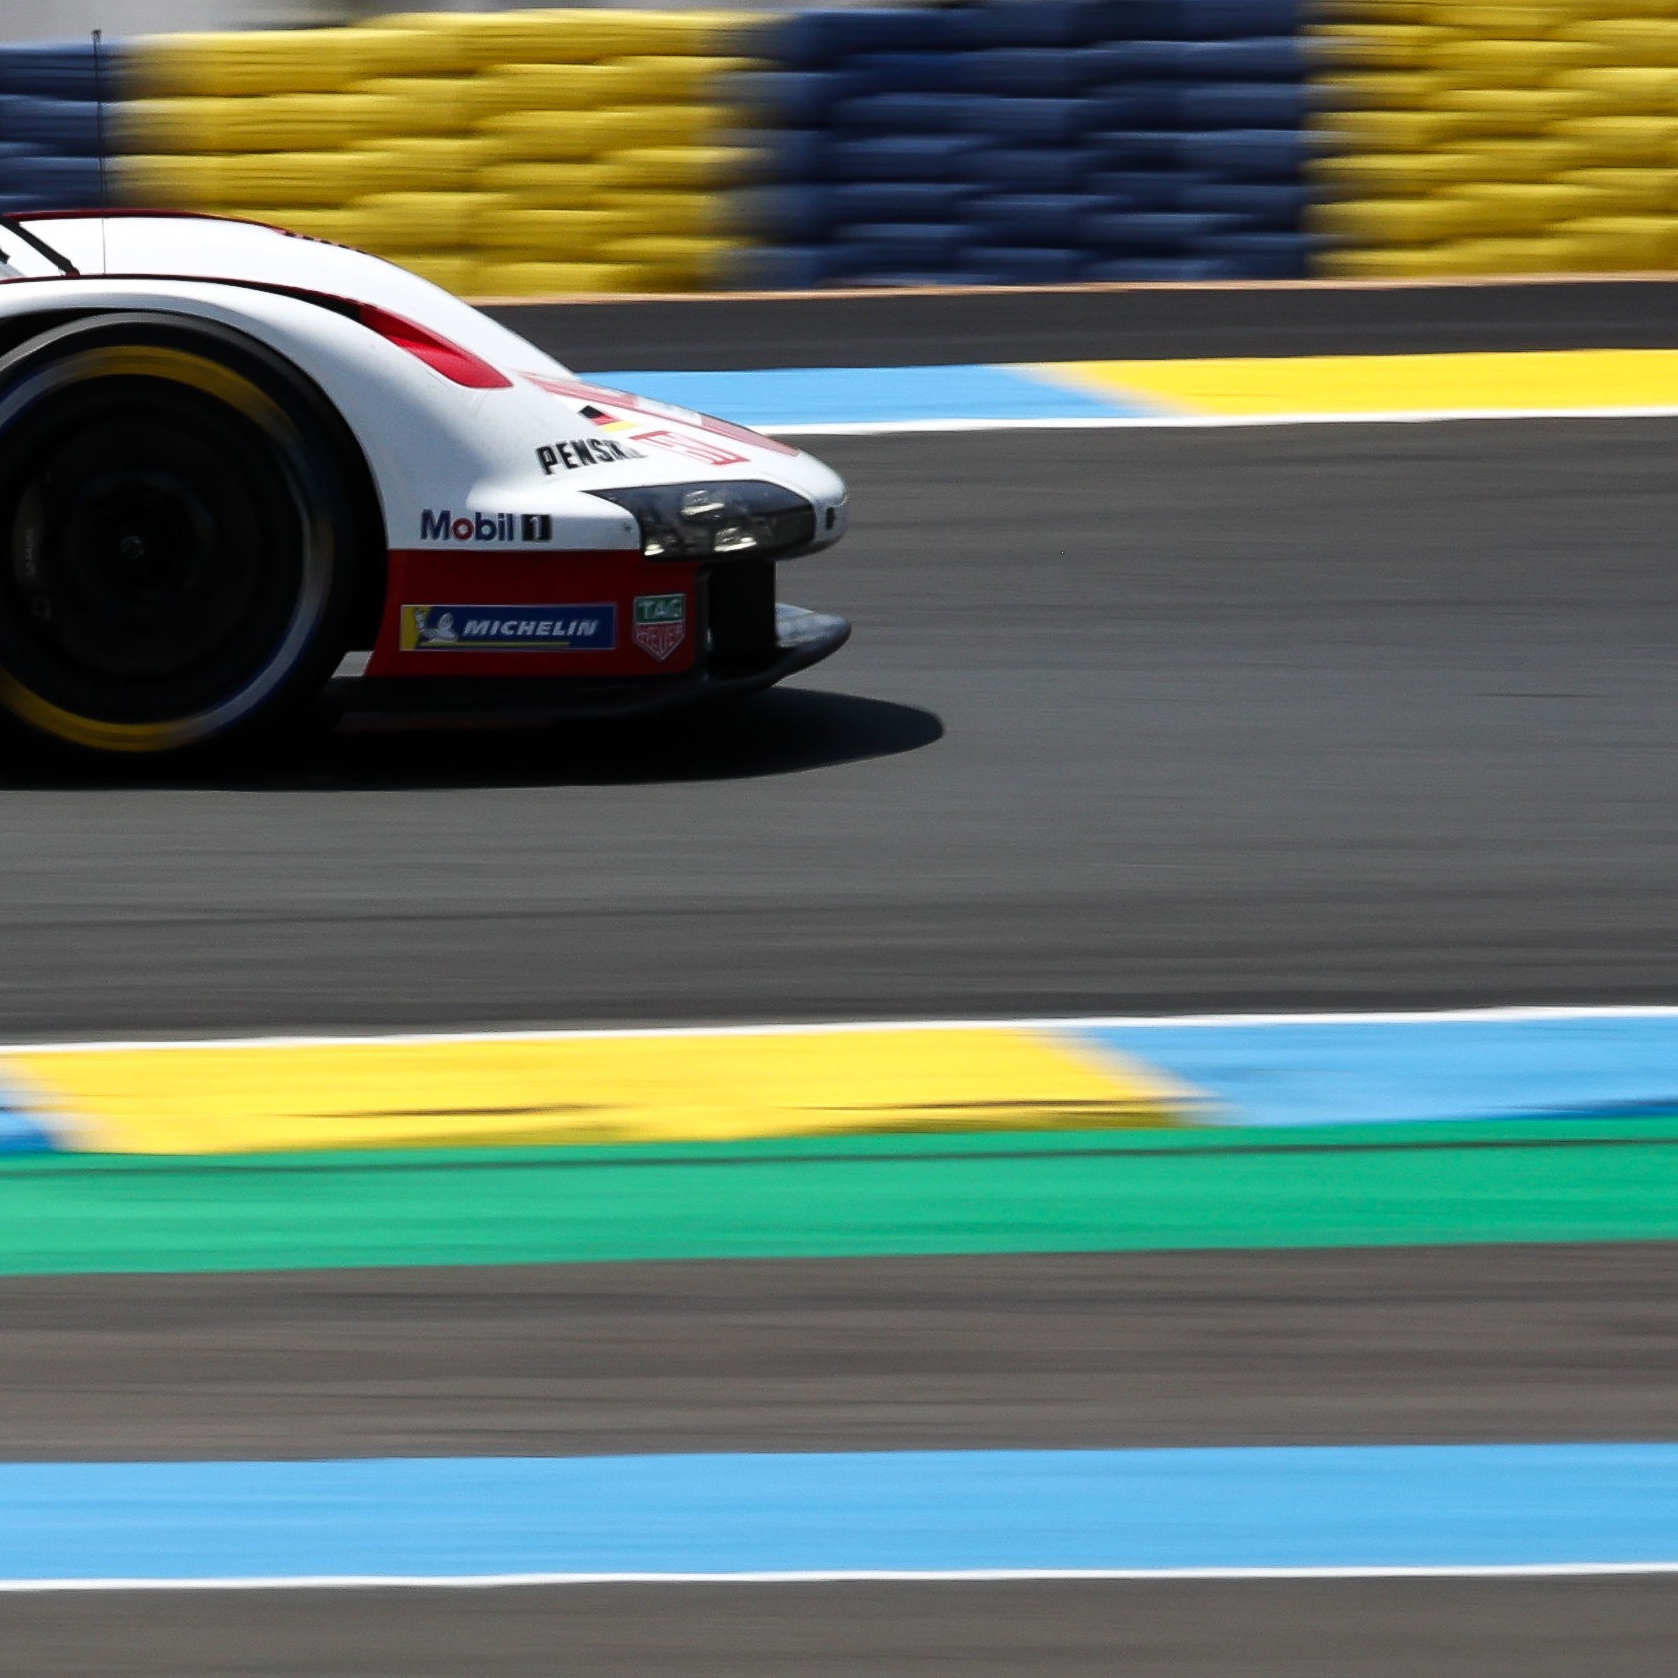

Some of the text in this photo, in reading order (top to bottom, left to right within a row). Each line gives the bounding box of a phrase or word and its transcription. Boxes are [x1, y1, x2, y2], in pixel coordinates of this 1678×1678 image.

[420, 507, 515, 542] Mobil
[637, 598, 683, 620] TAG
[462, 619, 599, 637] MICHELIN
